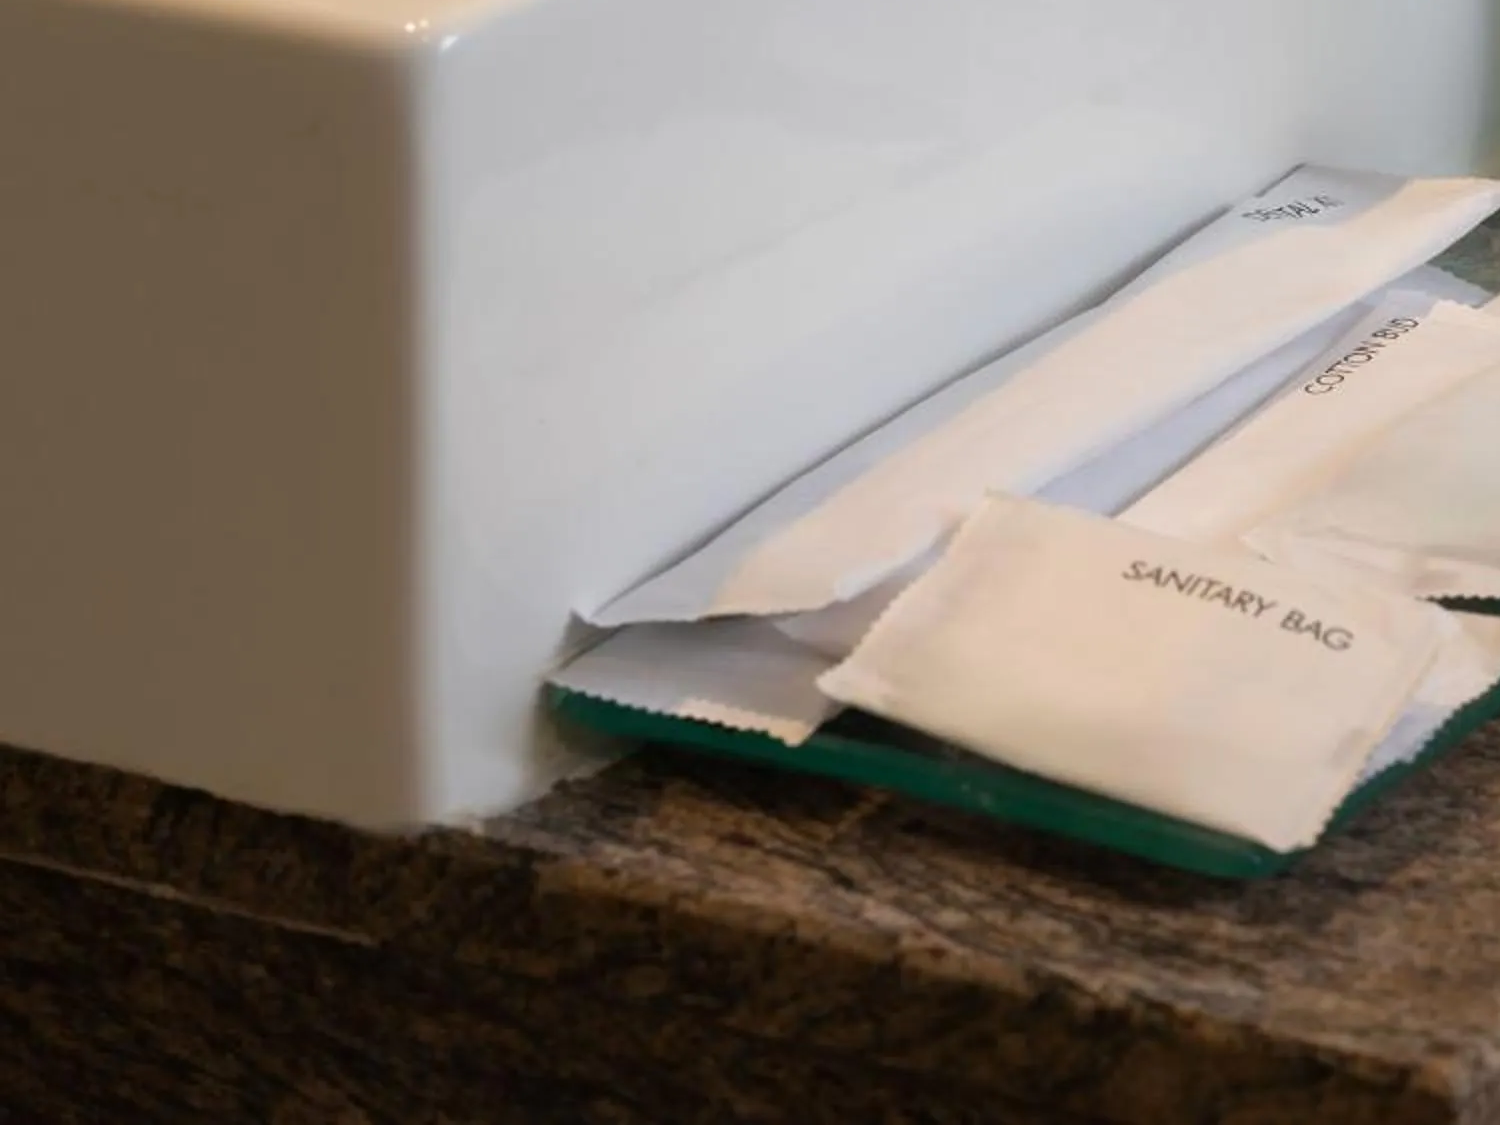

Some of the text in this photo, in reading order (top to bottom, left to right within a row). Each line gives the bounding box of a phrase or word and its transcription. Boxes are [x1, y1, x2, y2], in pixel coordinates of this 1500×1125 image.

[1304, 317, 1420, 396] COTTON BUD
[1121, 559, 1355, 652] SANITARY BAG
